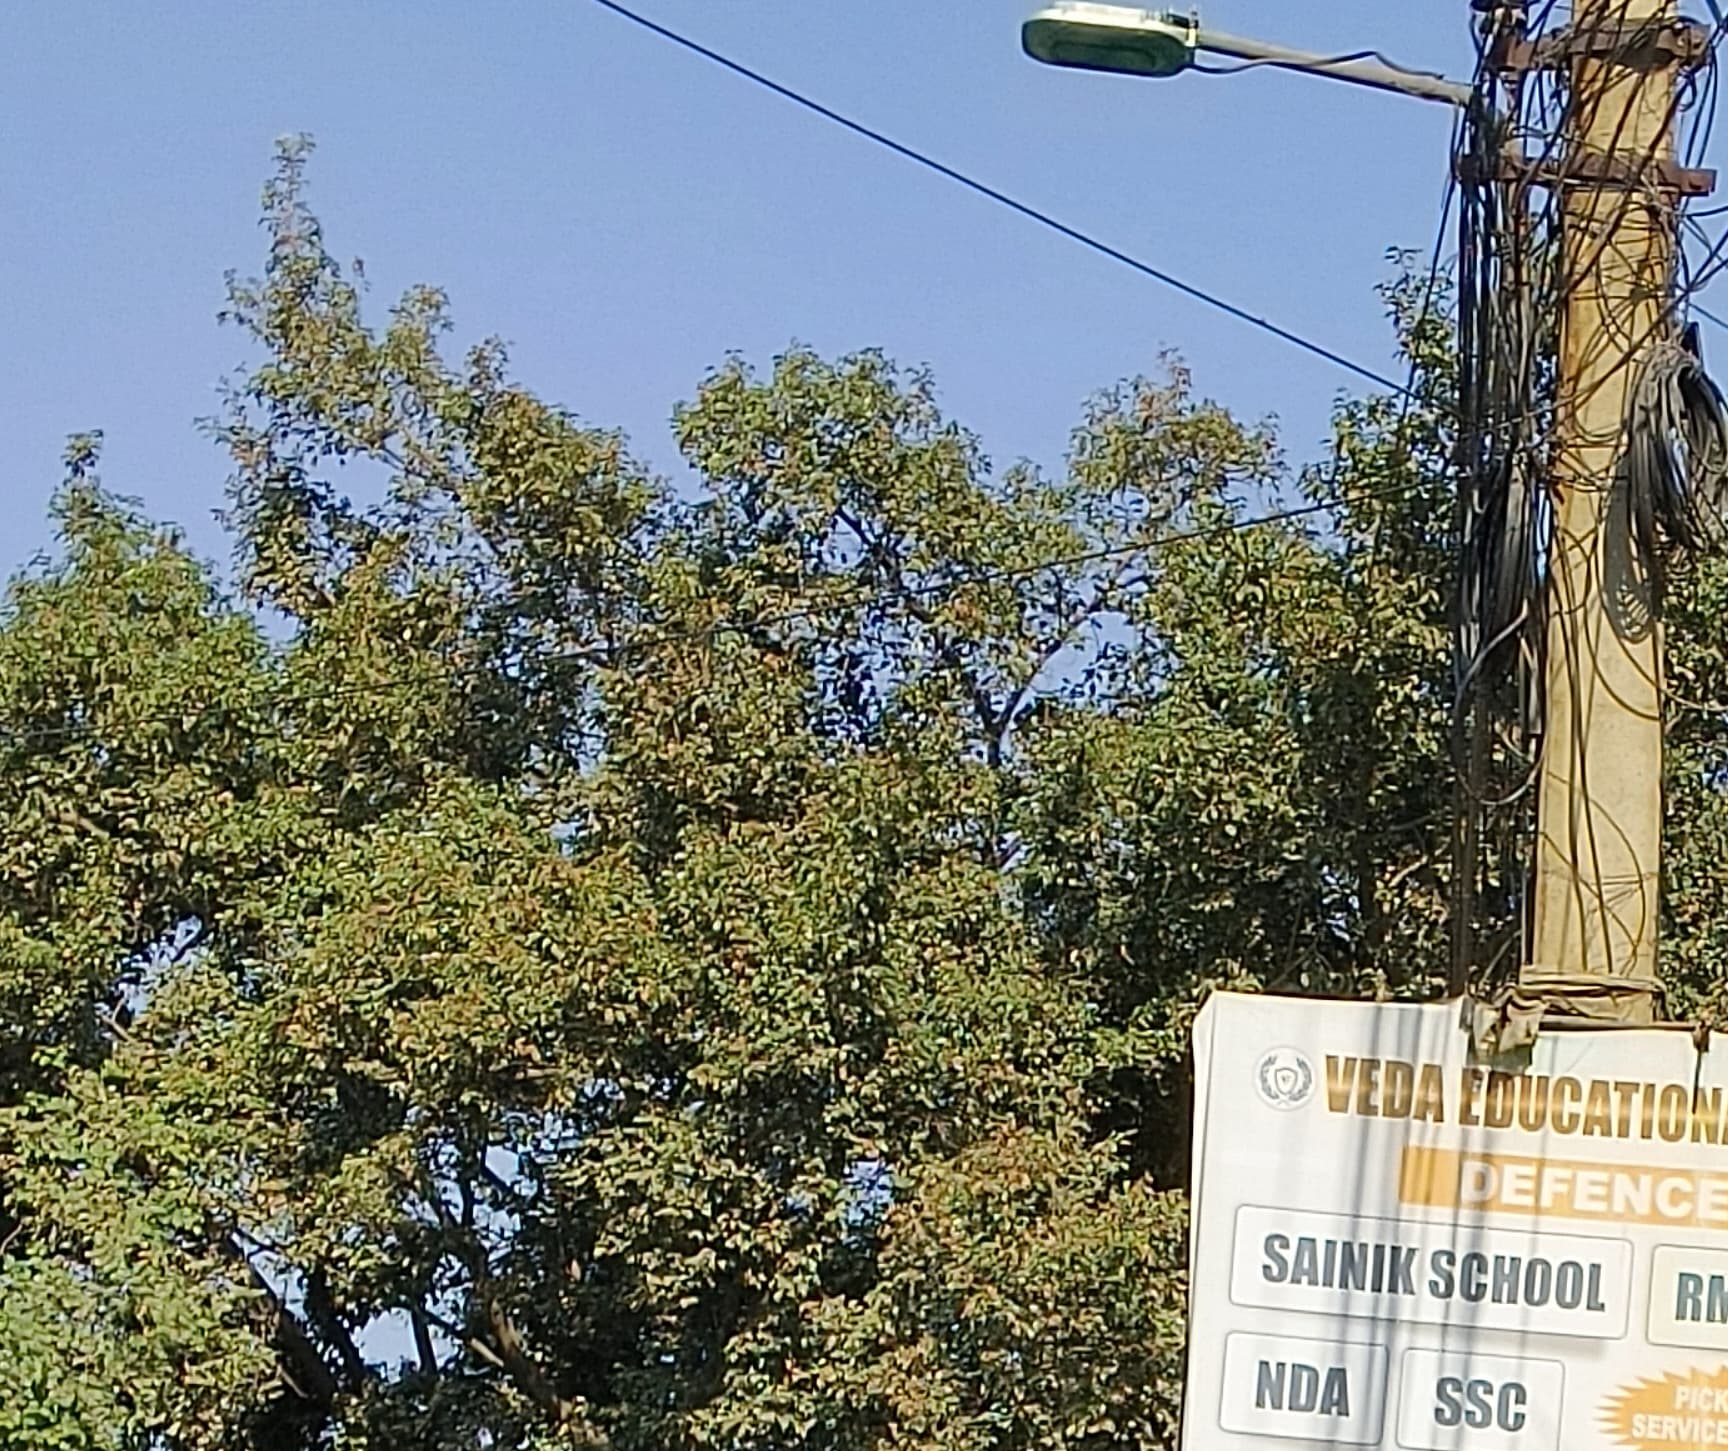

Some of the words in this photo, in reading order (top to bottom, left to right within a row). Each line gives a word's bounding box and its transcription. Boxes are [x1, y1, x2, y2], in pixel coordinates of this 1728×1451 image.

[1326, 1055, 1444, 1123] VEDA
[1262, 1233, 1419, 1295] SAINIK
[1429, 1249, 1605, 1312] SCHOOL
[1255, 1360, 1350, 1417] NDA
[1434, 1376, 1527, 1432] SSC
